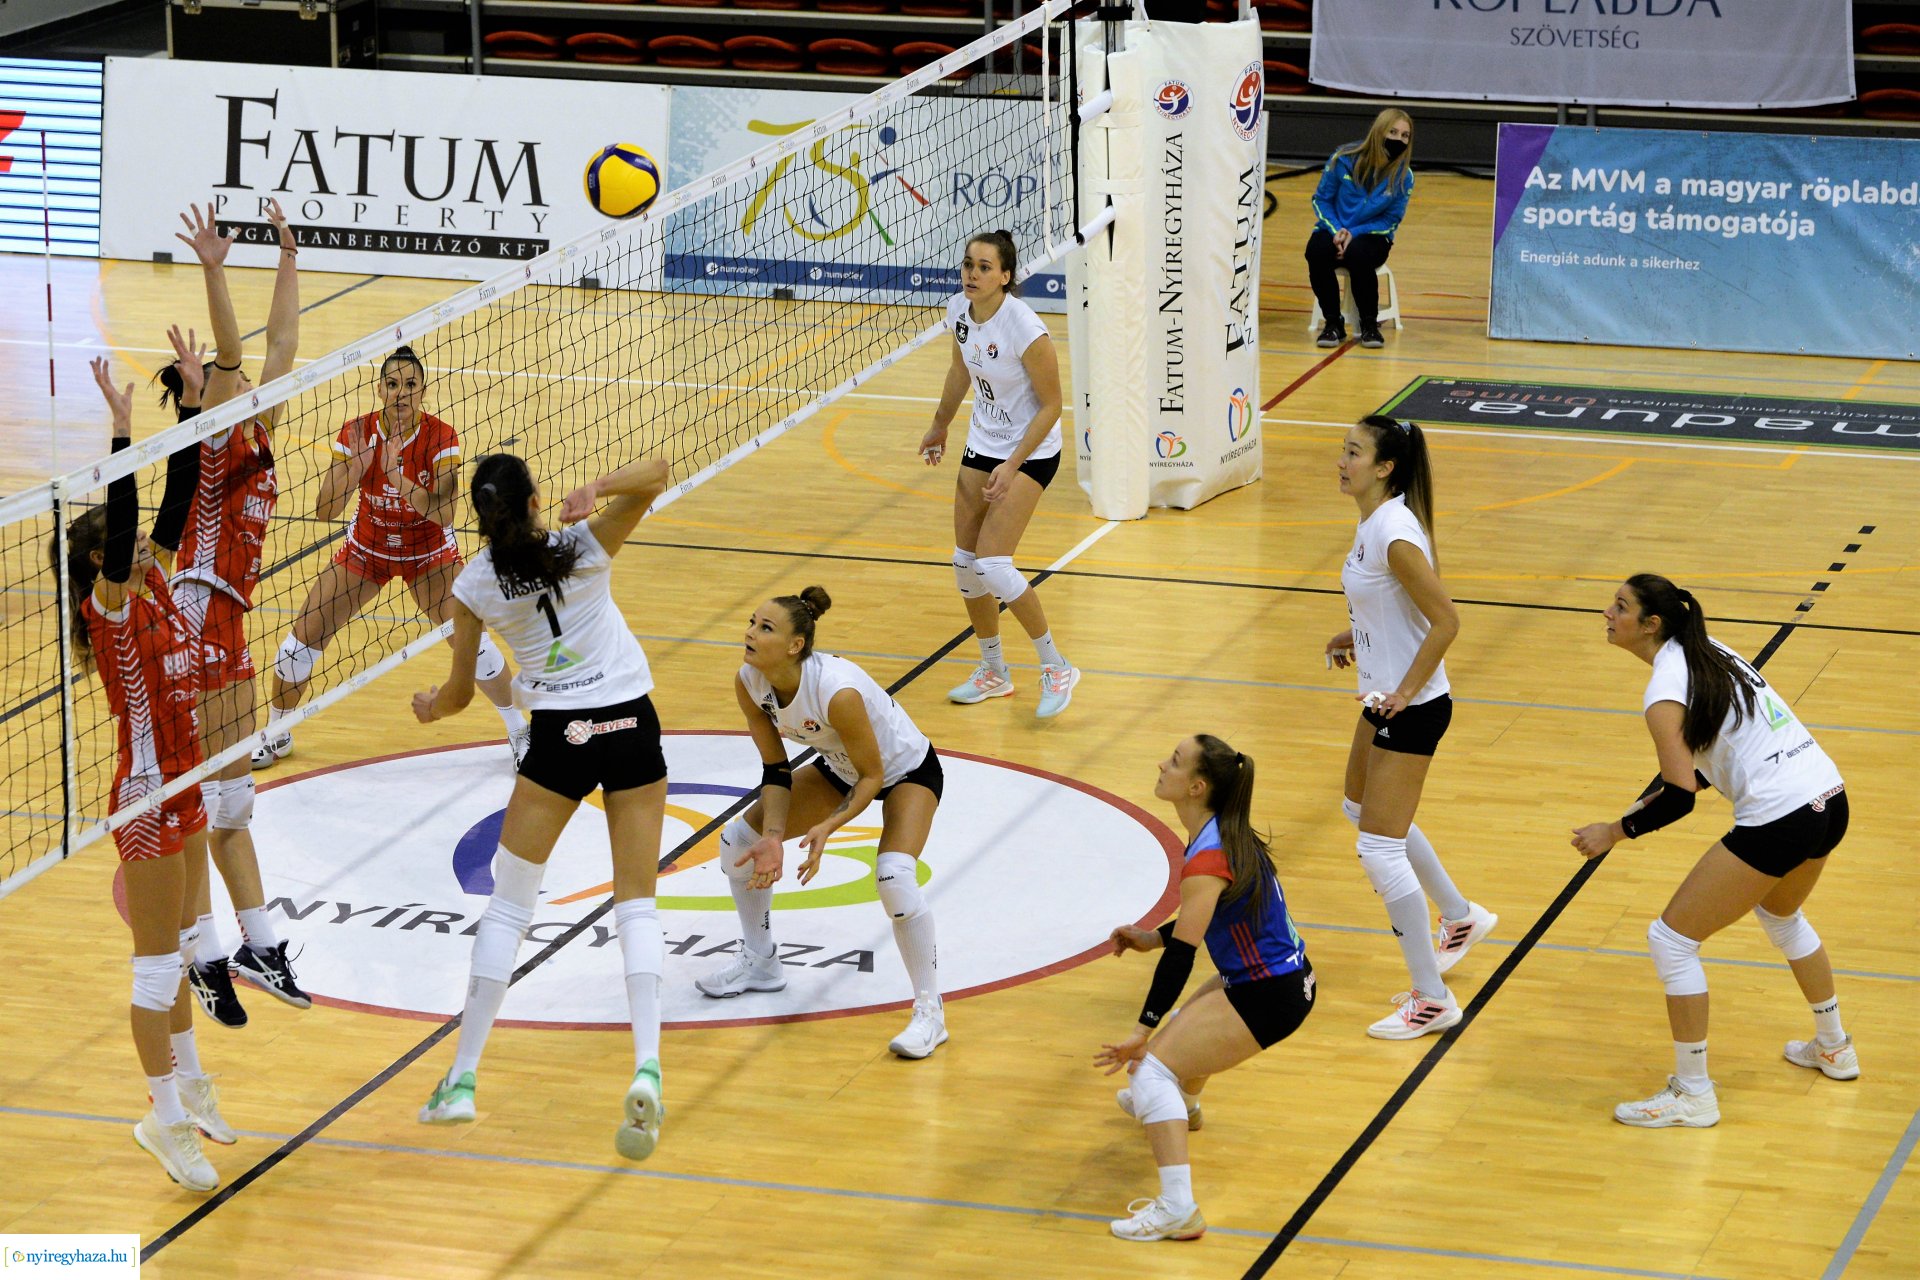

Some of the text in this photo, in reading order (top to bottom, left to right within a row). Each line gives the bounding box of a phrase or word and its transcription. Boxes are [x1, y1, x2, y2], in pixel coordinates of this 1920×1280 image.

[1510, 24, 1640, 50] SZÖVETSÉG
[212, 88, 550, 207] FATUM
[1525, 166, 1920, 208] Az MVM a magyar röplabd
[214, 194, 549, 234] PROPERTY
[1523, 202, 1815, 241] sportág támogatója
[500, 242, 544, 256] KFT
[1520, 250, 1700, 271] Energiát adunk a sikerhez
[719, 264, 759, 276] hunvolley
[823, 270, 864, 281] hunvolley
[1225, 165, 1254, 361] FATUM
[976, 375, 995, 401] 19
[1220, 439, 1257, 465] NYÍREGYHÁZA
[536, 593, 562, 638] 1
[546, 672, 604, 693] BESTRONG
[592, 717, 637, 734] REVESZ
